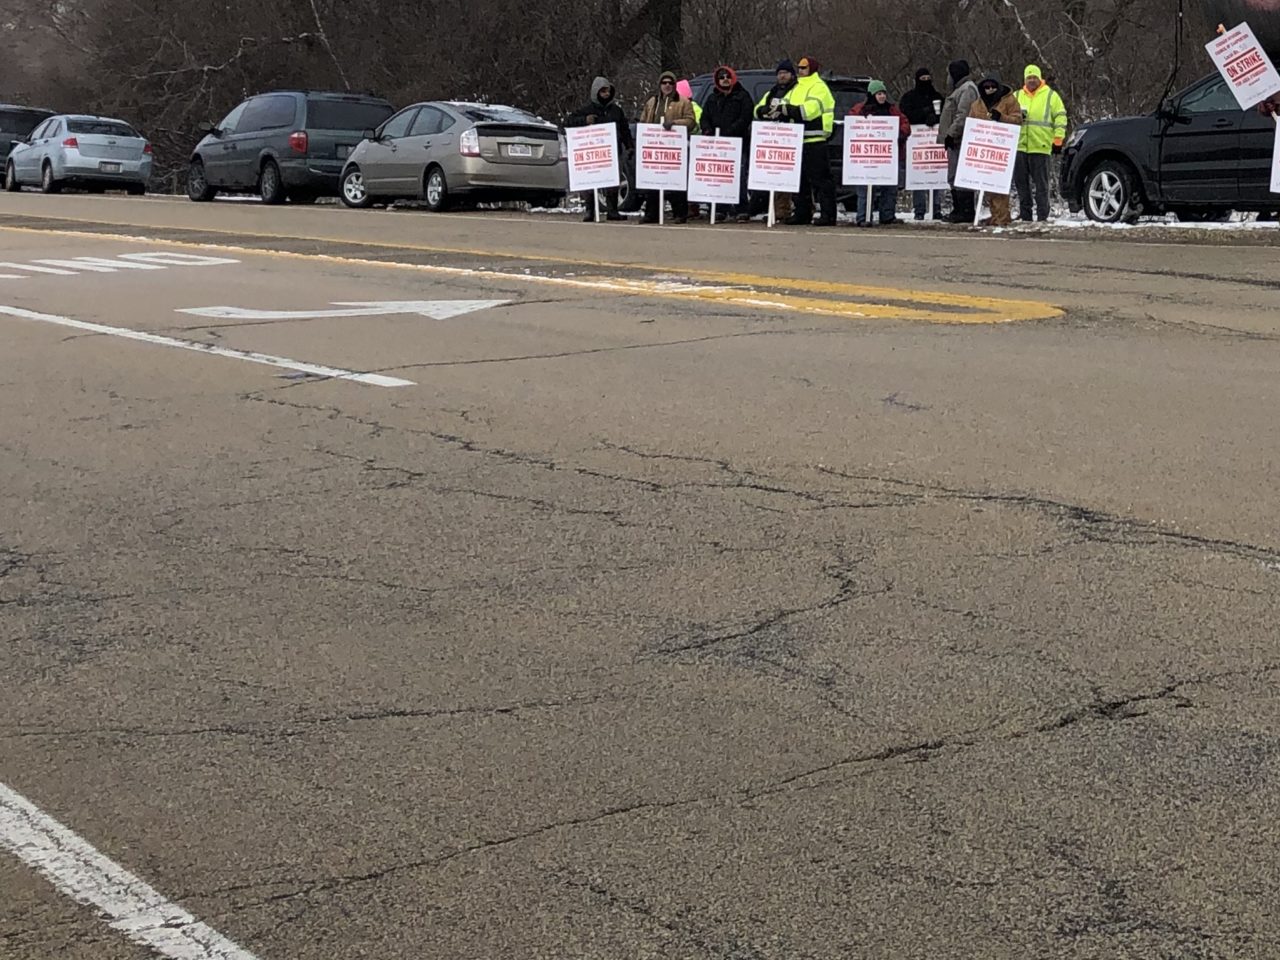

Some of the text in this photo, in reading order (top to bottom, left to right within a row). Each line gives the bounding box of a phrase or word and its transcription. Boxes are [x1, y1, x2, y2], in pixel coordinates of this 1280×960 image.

[1225, 50, 1262, 78] ON STRIKE
[850, 144, 891, 153] ON STRIKE
[966, 146, 1009, 162] ON STRIKE
[574, 149, 611, 161] ON STRIKE
[642, 150, 681, 160] ON STRIKE
[755, 149, 795, 160] ON STRIKE
[913, 151, 922, 161] ON
[695, 162, 734, 173] ON STRIKE
